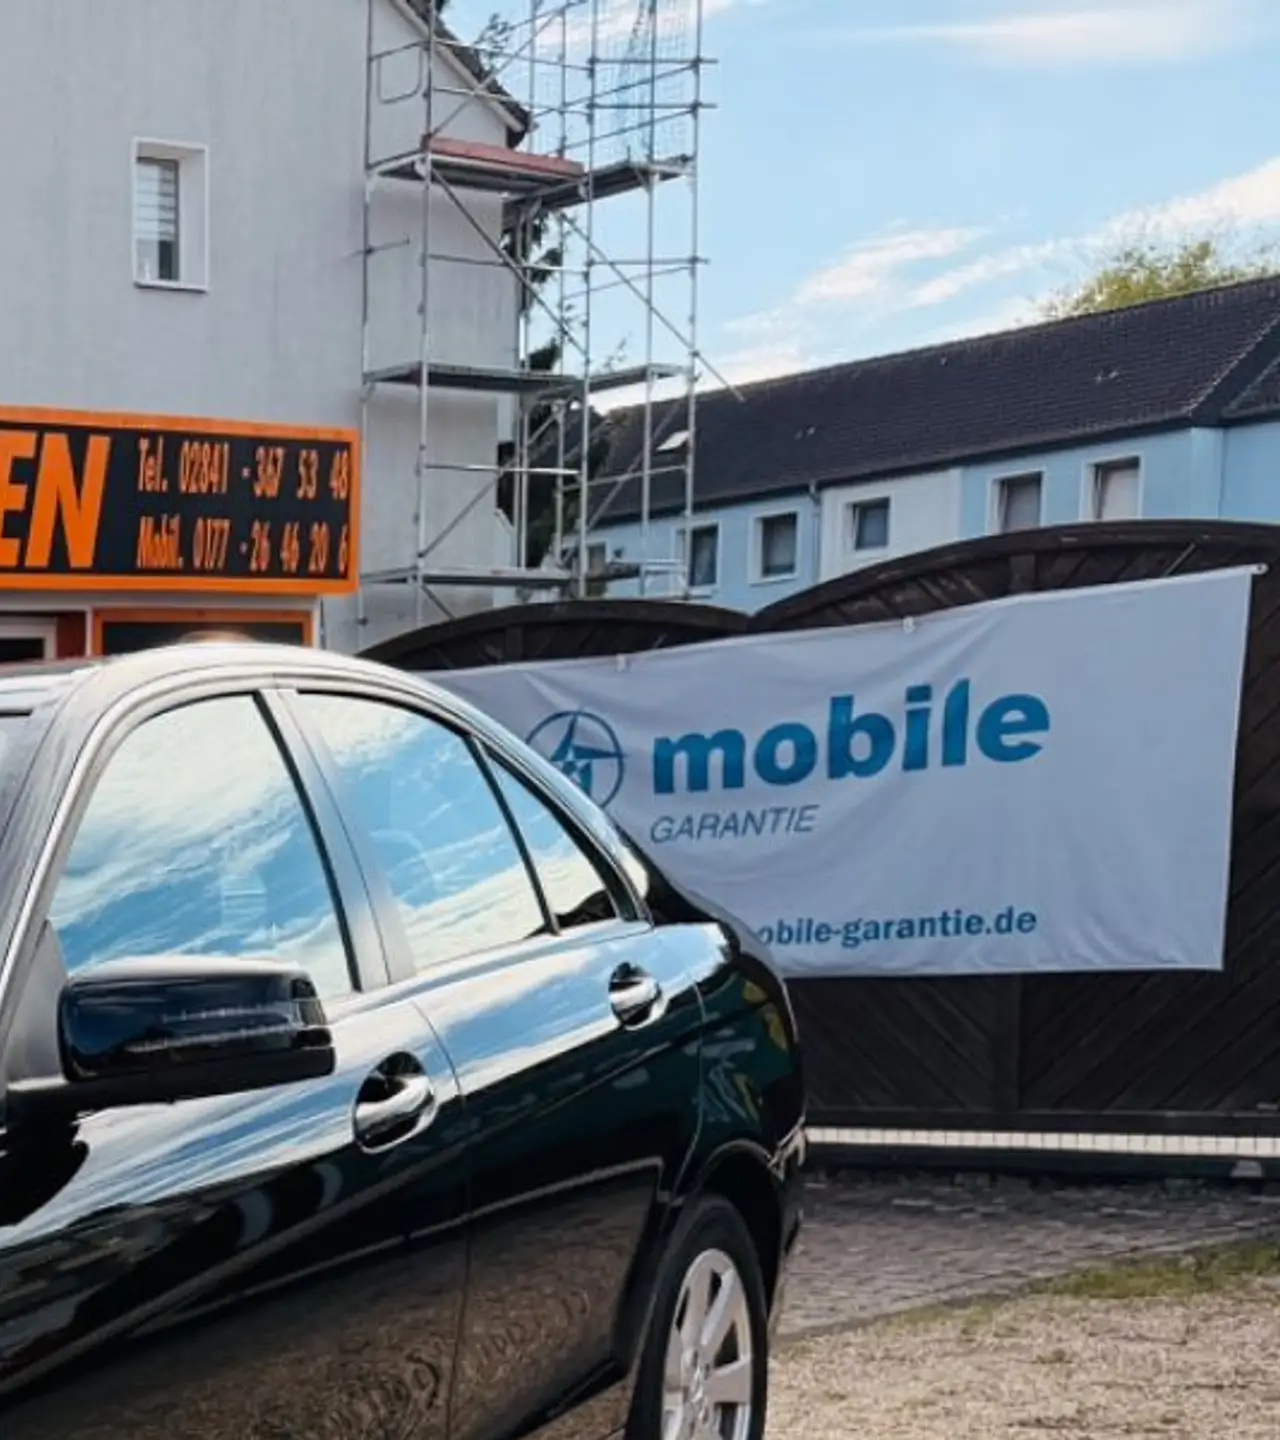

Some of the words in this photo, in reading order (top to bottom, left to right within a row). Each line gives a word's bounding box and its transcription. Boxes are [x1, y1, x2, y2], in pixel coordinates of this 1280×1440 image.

[137, 436, 169, 493] Tel.
[178, 439, 231, 494] 02841
[329, 449, 349, 501] 48
[136, 512, 184, 570] Mobil.
[192, 517, 231, 570] 0177
[651, 678, 1051, 796] mobile
[650, 804, 820, 844] GARANTIE
[756, 904, 1038, 949] obile-garantie.de
